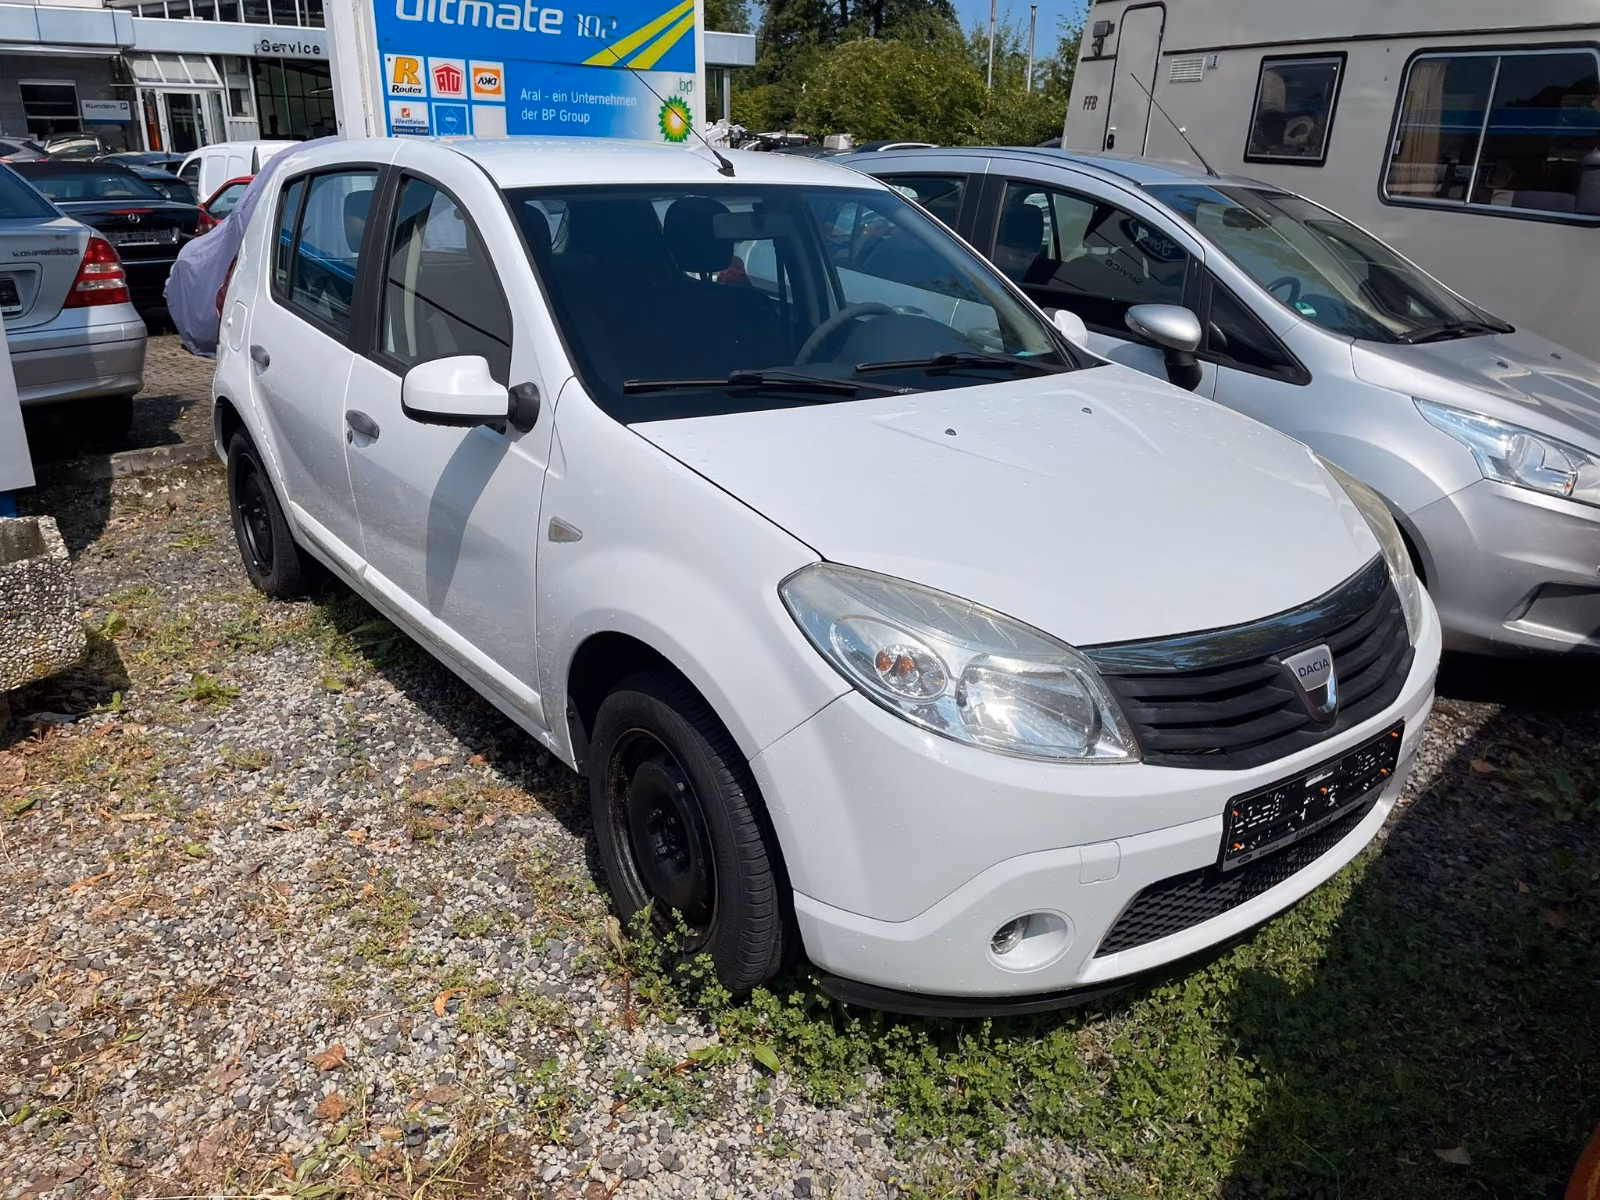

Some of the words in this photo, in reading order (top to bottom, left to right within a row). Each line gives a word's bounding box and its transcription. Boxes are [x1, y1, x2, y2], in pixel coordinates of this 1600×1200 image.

[261, 39, 320, 54] Service
[391, 84, 422, 94] Routex
[679, 76, 692, 95] bp
[520, 88, 541, 101] Aral
[552, 91, 567, 102] ein
[571, 91, 637, 107] Unternehmen
[1083, 95, 1098, 111] FFB
[521, 108, 538, 121] der
[542, 109, 556, 121] BP
[559, 110, 590, 125] Group
[1298, 658, 1330, 677] DACIA
